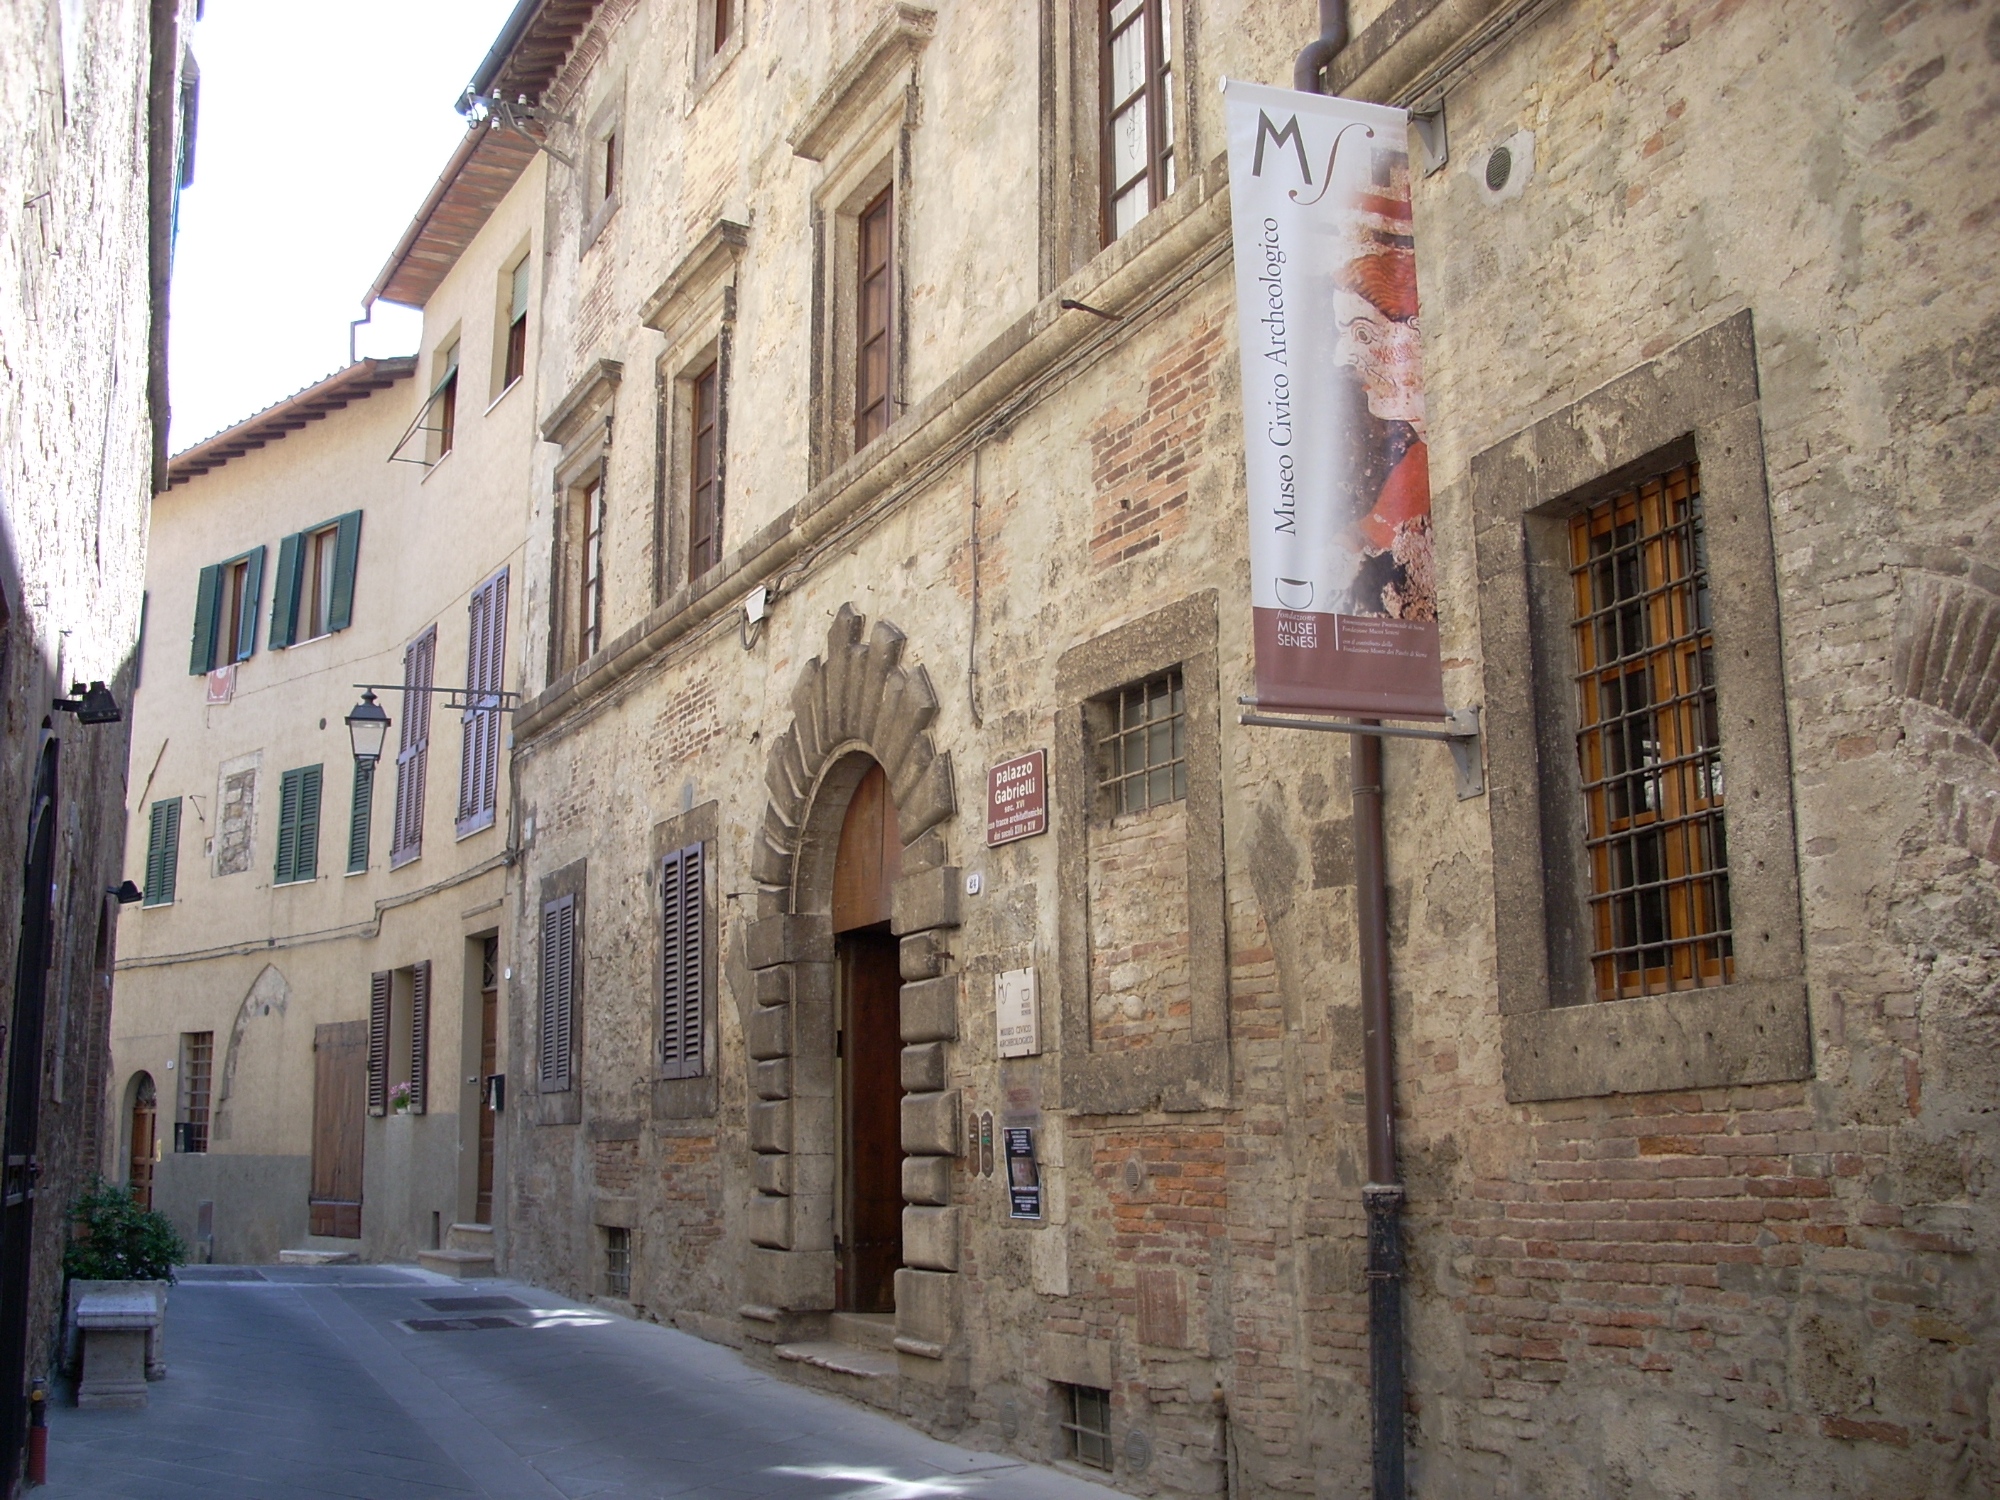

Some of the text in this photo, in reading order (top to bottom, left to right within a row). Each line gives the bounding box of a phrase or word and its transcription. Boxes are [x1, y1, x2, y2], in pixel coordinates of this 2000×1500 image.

[1258, 217, 1296, 536] Museo Civico Archeologico
[1276, 609, 1316, 621] fondazione
[1277, 620, 1317, 635] MUSEI
[1277, 633, 1317, 648] SENESI
[996, 761, 1033, 787] palazzo
[994, 777, 1035, 805] Gabrielli
